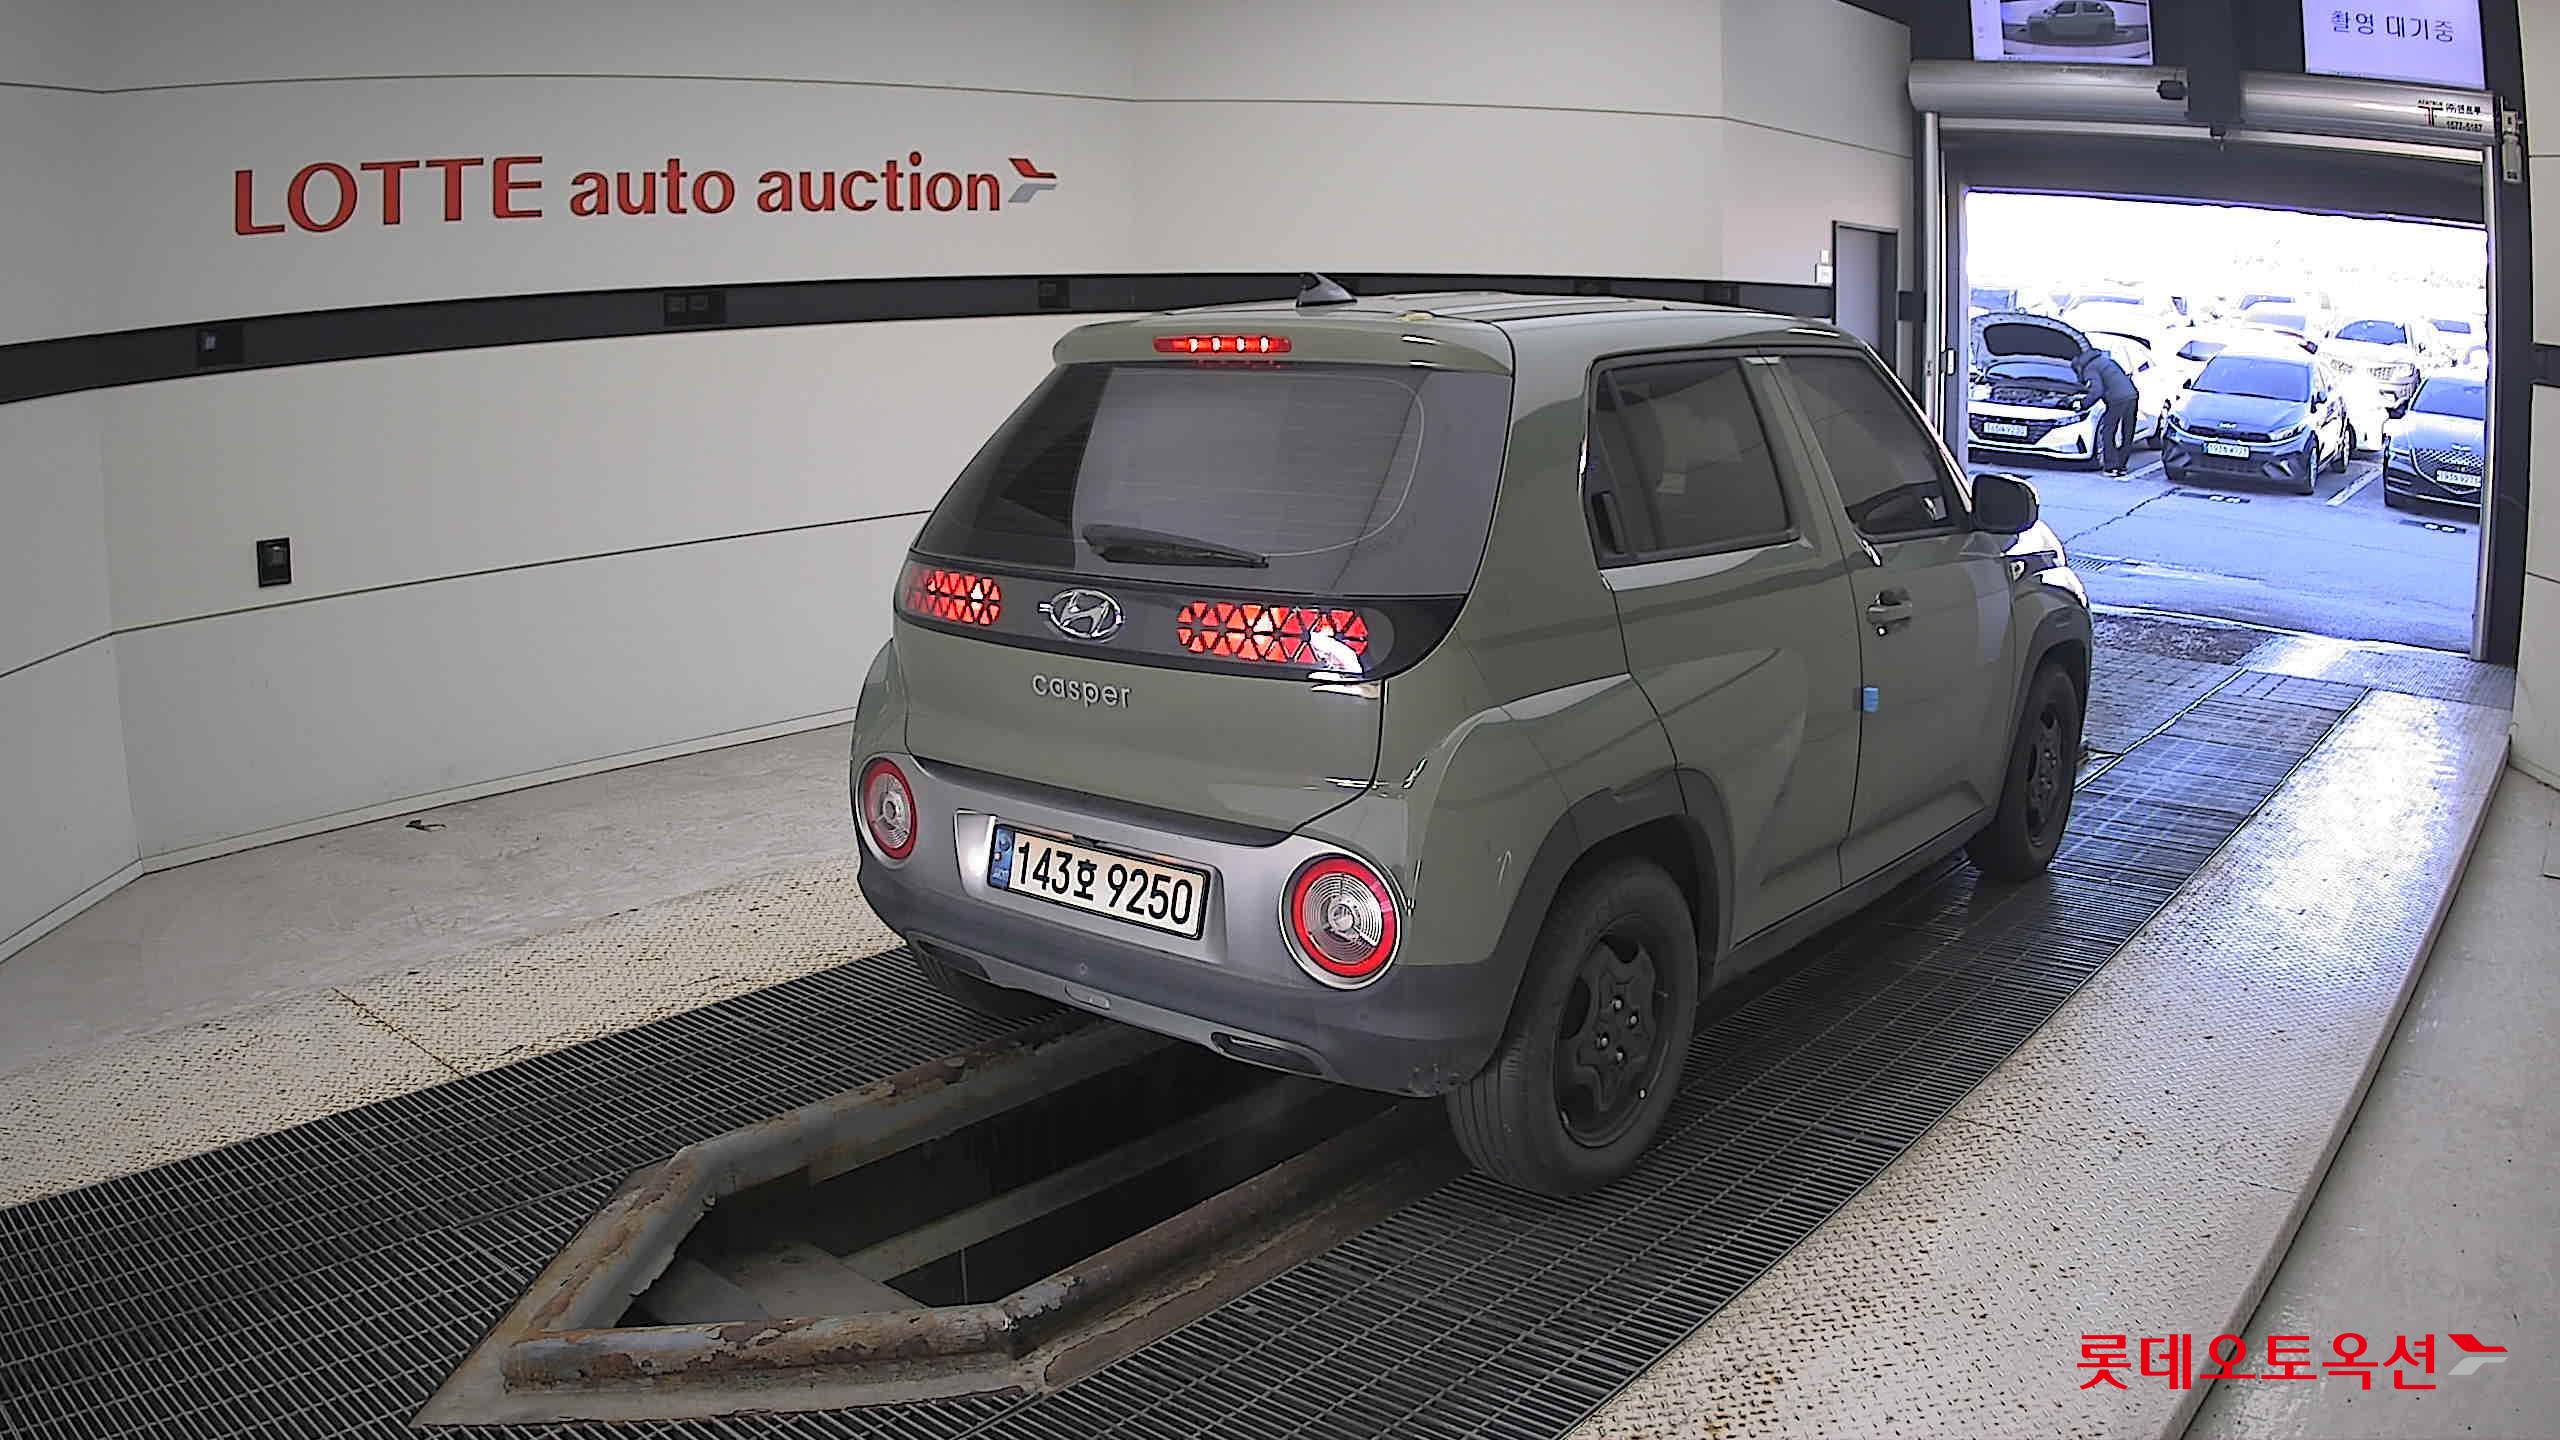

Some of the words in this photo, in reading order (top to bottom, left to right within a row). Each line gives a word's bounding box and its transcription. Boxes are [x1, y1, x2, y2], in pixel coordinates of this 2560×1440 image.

[2331, 9, 2374, 36] 촬영
[2386, 15, 2454, 43] 대기중
[234, 155, 543, 236] LOTTE
[569, 157, 736, 217] auto
[756, 150, 1001, 213] auction
[1031, 673, 1131, 709] casper
[1017, 841, 1098, 901] 143호
[1107, 863, 1193, 925] 9250
